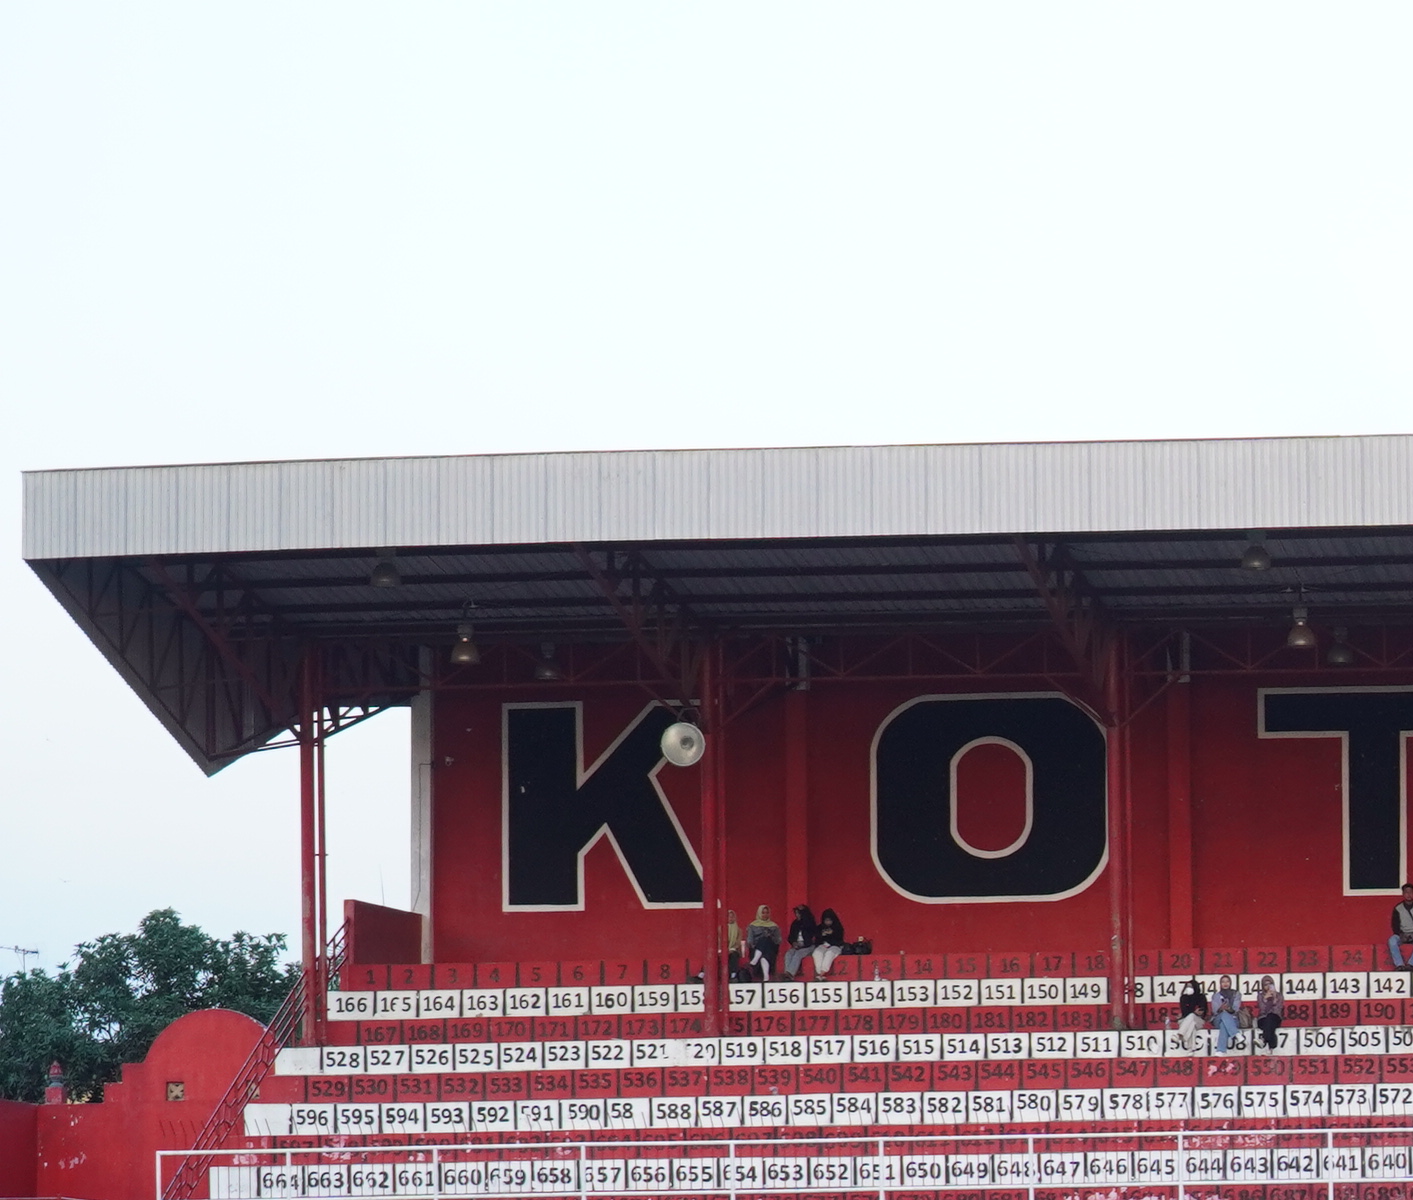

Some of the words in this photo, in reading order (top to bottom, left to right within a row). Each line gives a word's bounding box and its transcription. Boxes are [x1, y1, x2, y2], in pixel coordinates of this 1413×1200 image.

[336, 996, 368, 1013] 166
[467, 994, 499, 1011] 163
[552, 992, 584, 1009] 161
[768, 988, 800, 1004] 156
[854, 986, 887, 1003] 154
[941, 984, 973, 1001] 152
[1027, 983, 1059, 1000] 150
[1374, 977, 1406, 994] 142
[326, 1051, 360, 1069] 528
[458, 1048, 494, 1066] 525
[548, 1045, 581, 1062] 523
[725, 1041, 758, 1058] 519
[858, 1039, 890, 1057] 516
[1036, 1036, 1067, 1053] 512
[1303, 1031, 1337, 1049] 506
[296, 1109, 329, 1127] 596
[431, 1107, 464, 1125] 593
[656, 1103, 692, 1120] 588
[927, 1096, 963, 1114] 582
[1016, 1093, 1051, 1112] 580
[1244, 1091, 1279, 1108] 575
[1379, 1087, 1413, 1105] 572
